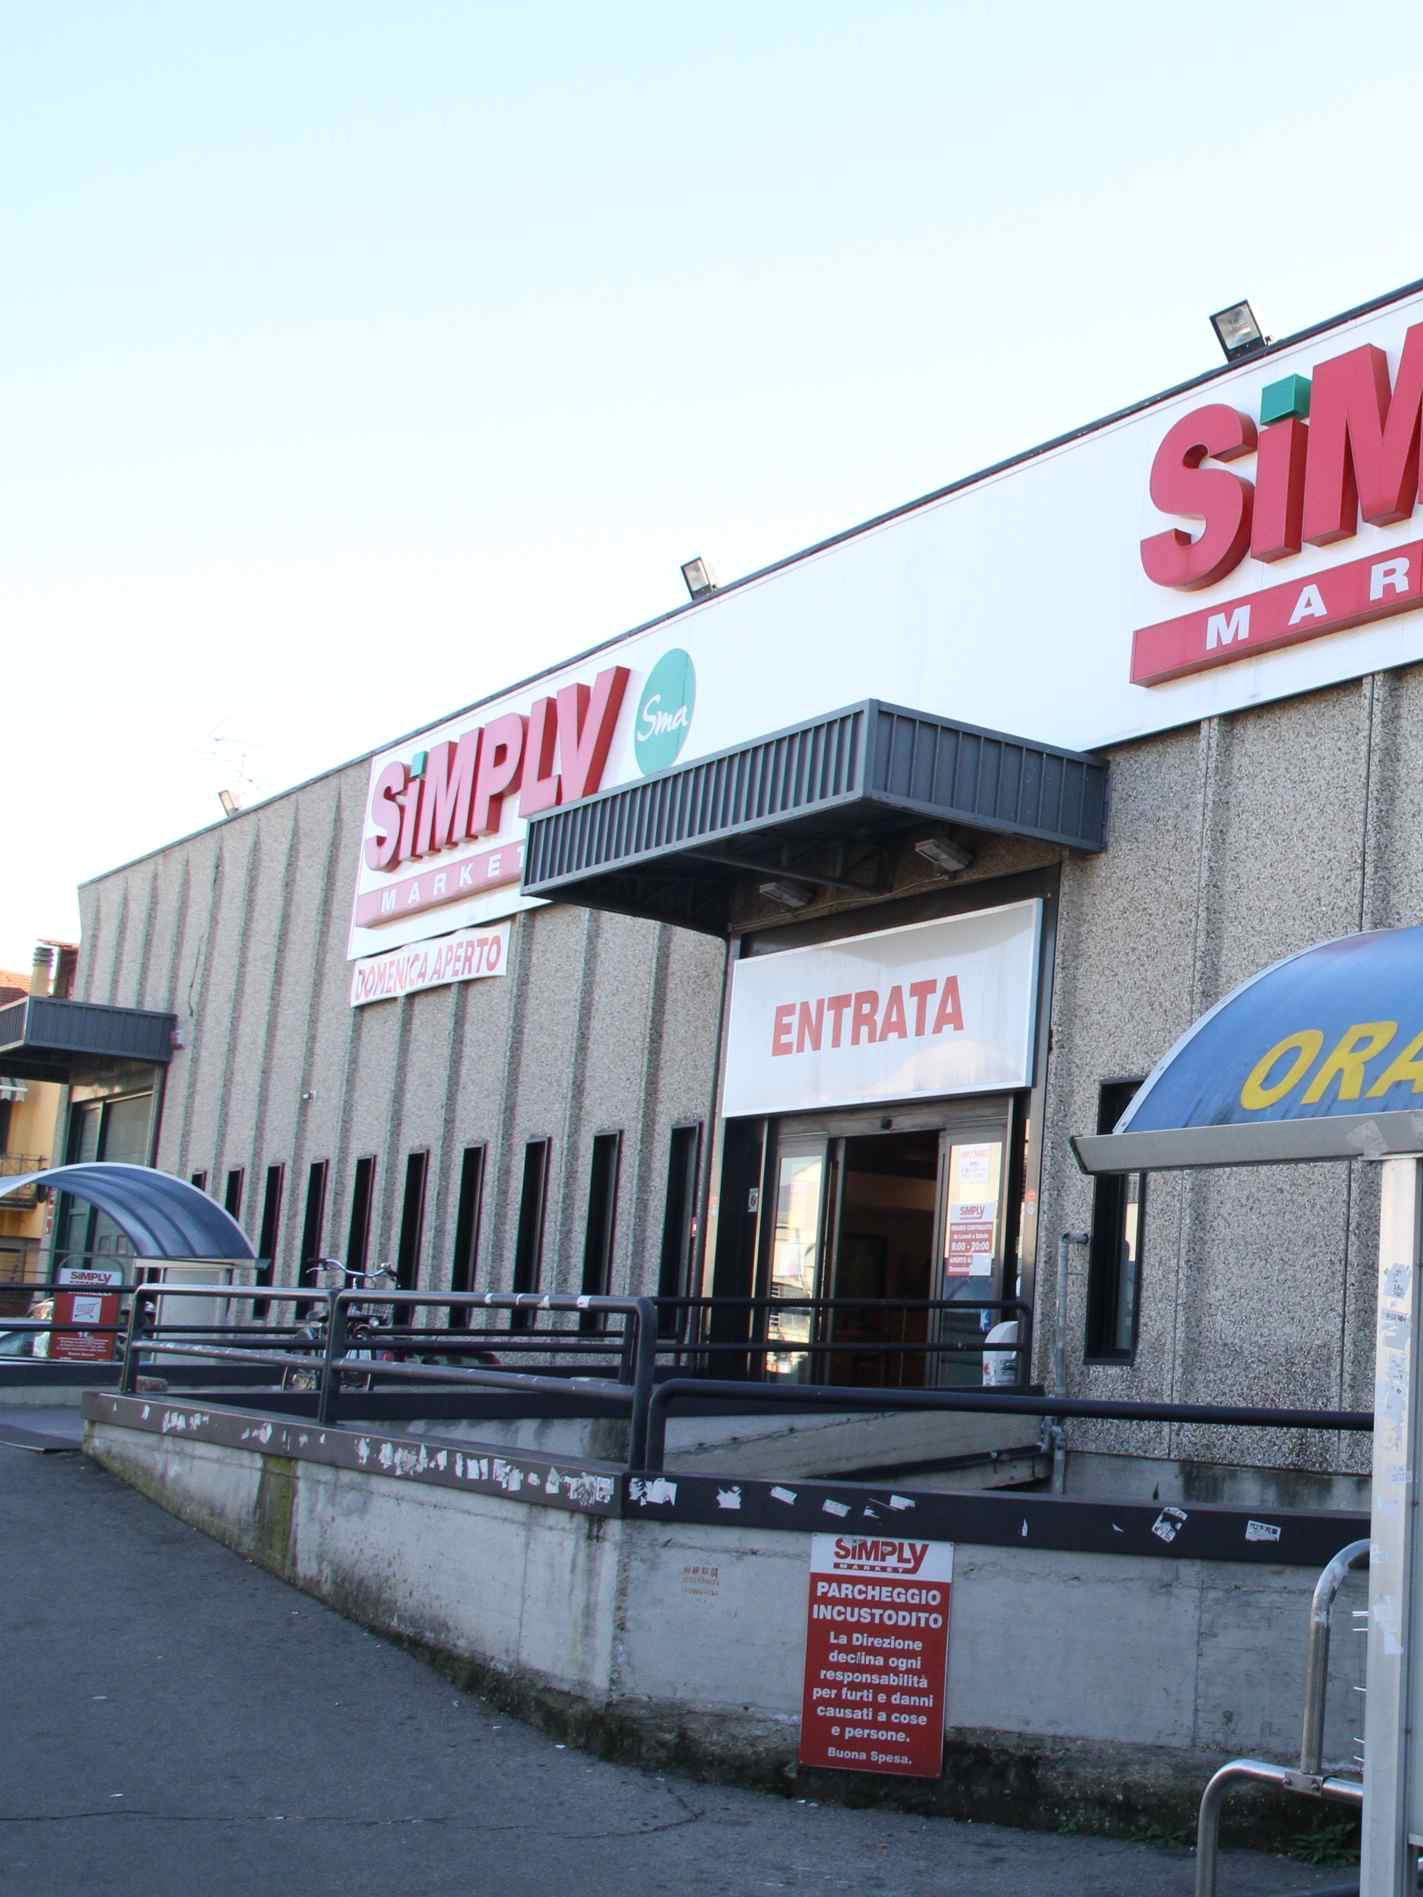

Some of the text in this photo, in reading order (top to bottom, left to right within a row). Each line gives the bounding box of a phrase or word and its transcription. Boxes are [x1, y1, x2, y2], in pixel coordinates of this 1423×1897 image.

[637, 693, 689, 742] Sma
[356, 935, 502, 997] DOMENICA APERTO
[771, 975, 964, 1057] ENTRATA
[816, 1581, 941, 1605] PARCHEGGIO
[812, 1604, 943, 1629] INCUSTODITO
[830, 1632, 923, 1651] La Direzione
[828, 1650, 921, 1673] declina ogni
[819, 1668, 928, 1688] responsabilità
[812, 1686, 933, 1708] per furti e danni
[816, 1705, 927, 1726] causati a cose
[831, 1725, 910, 1743] e persone.
[827, 1746, 912, 1766] Buona Spesa.
